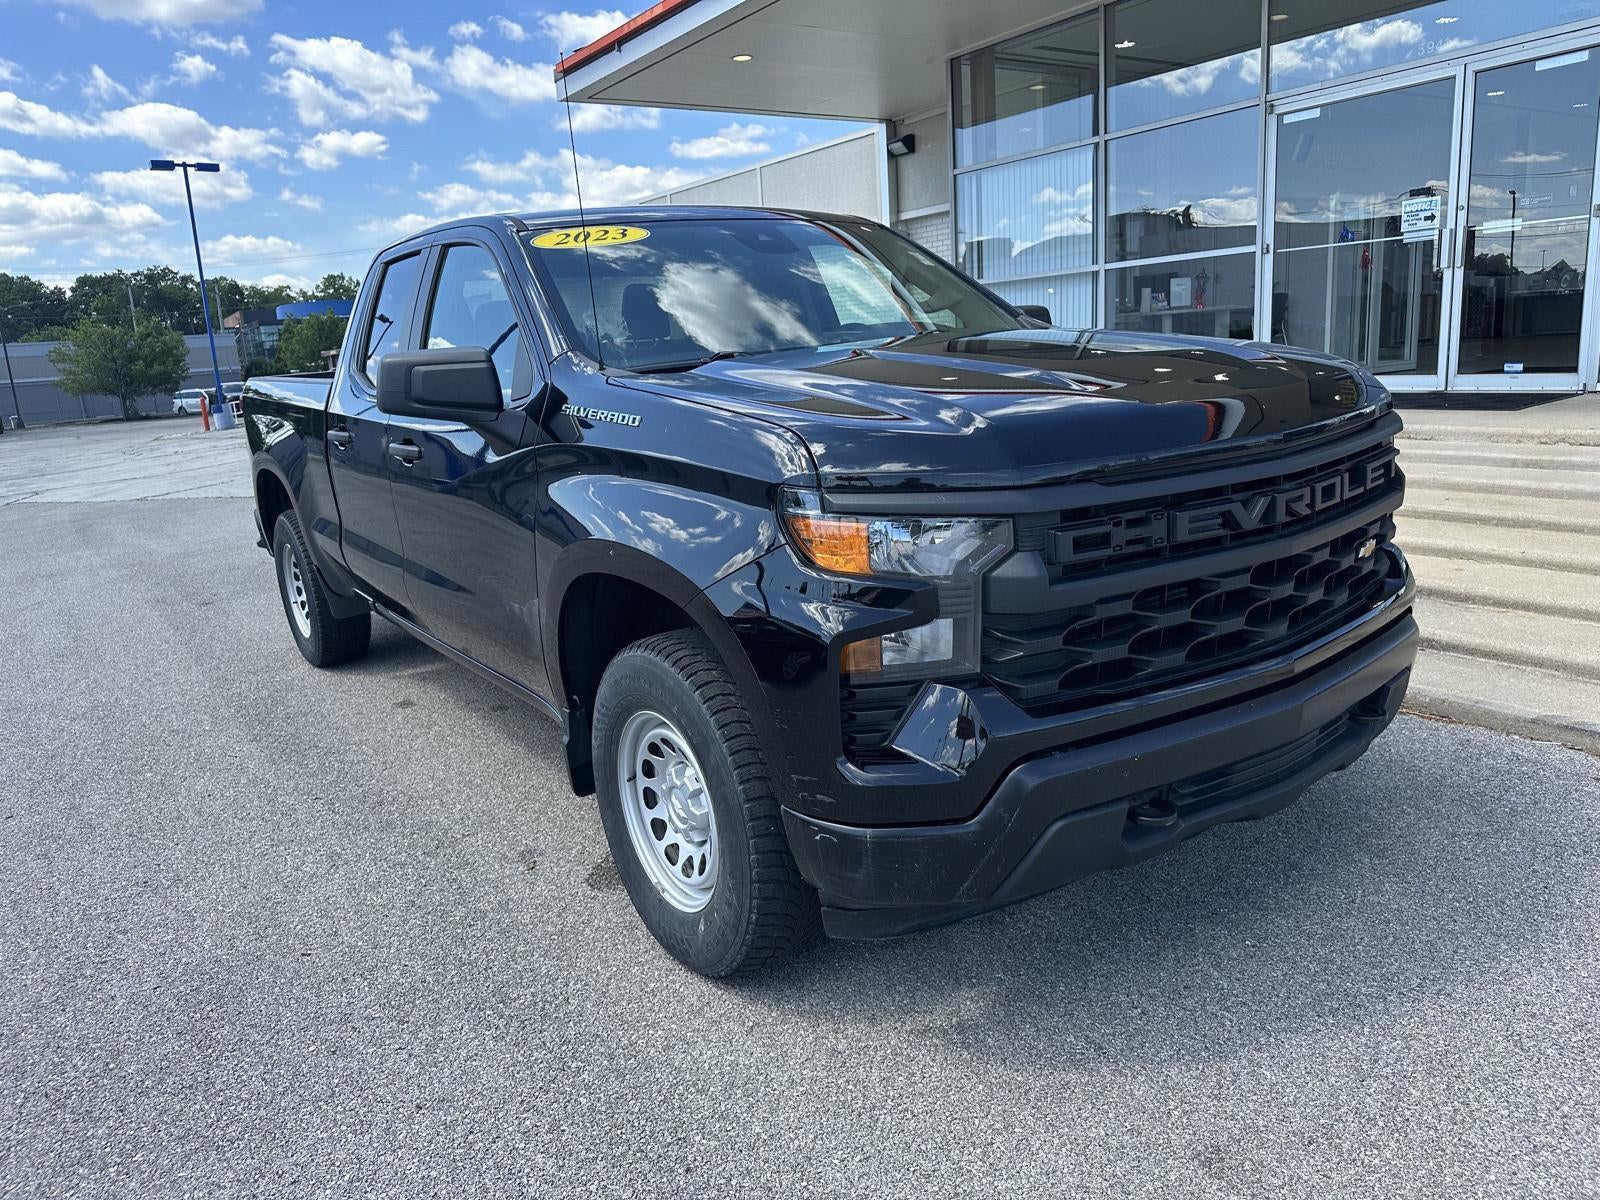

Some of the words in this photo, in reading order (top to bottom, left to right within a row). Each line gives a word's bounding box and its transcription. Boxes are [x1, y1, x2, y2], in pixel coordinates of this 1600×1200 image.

[1404, 200, 1437, 213] NOTICE
[554, 228, 628, 246] 2023
[560, 404, 641, 427] SILVERADO
